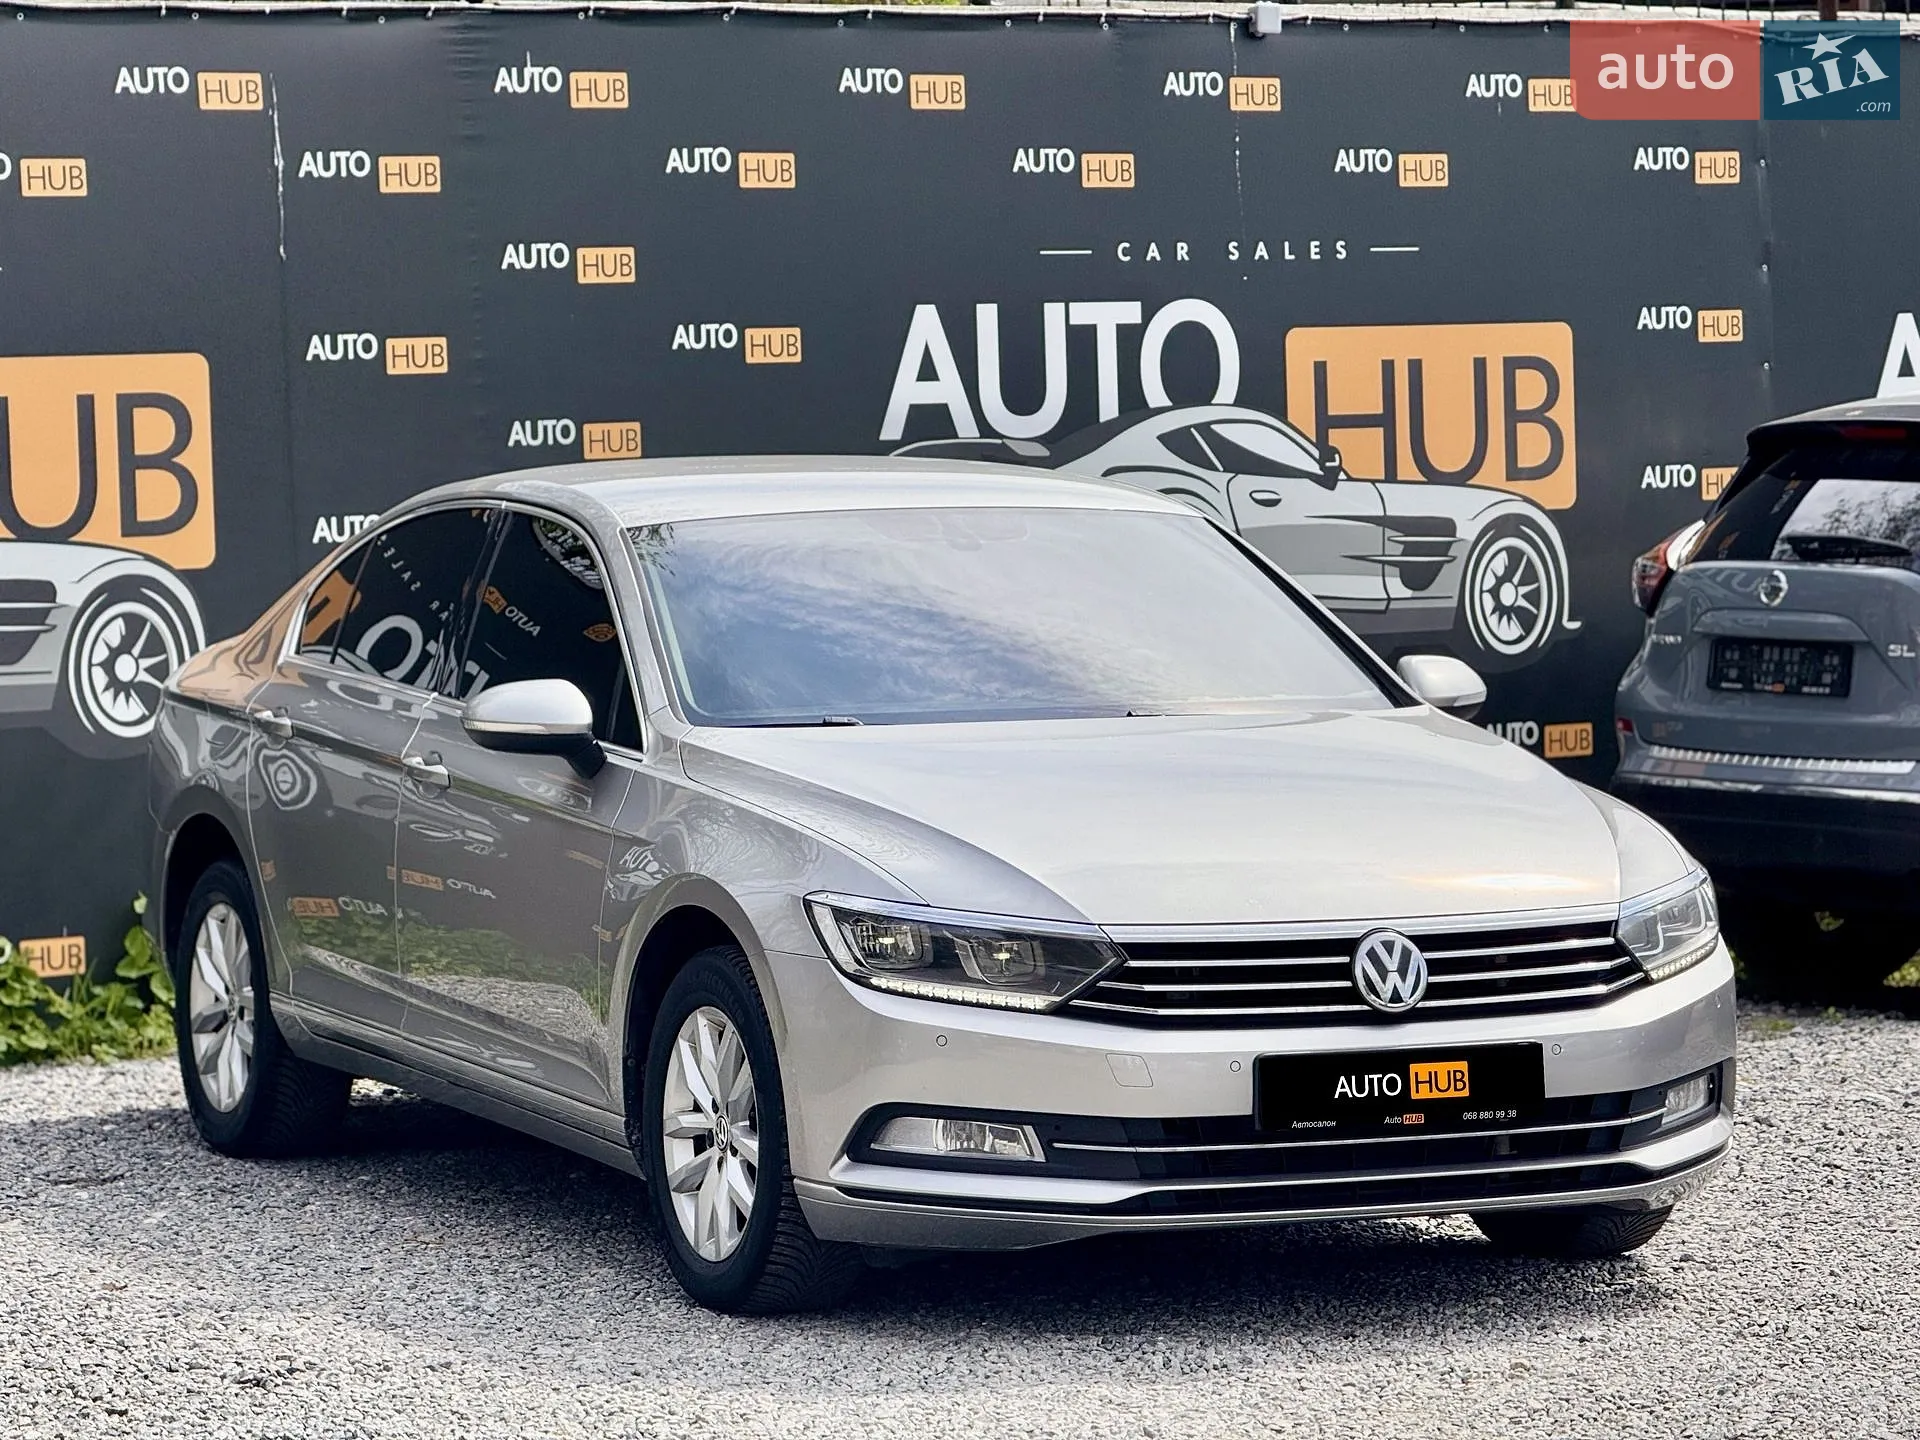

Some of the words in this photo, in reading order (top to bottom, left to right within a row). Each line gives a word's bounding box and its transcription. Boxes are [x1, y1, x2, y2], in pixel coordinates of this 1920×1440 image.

[115, 66, 189, 94] AUTO
[204, 80, 260, 104] HUB
[494, 66, 562, 93] AUTO
[575, 80, 628, 103] HUB
[839, 68, 903, 93] AUTO
[915, 82, 963, 105] HUB
[1163, 72, 1223, 96] AUTO
[1234, 84, 1279, 106] HUB
[1465, 74, 1522, 98] AUTO
[1532, 85, 1575, 107] HUB
[27, 165, 84, 191] HUB
[298, 151, 371, 178] AUTO
[384, 163, 438, 188] HUB
[666, 147, 731, 173] AUTO
[744, 159, 793, 183] HUB
[1013, 148, 1075, 173] AUTO
[1087, 160, 1132, 183] HUB
[1335, 149, 1392, 173] AUTO
[1404, 160, 1446, 183] HUB
[1634, 147, 1689, 170] AUTO
[1699, 157, 1738, 180] HUB
[501, 243, 569, 269] AUTO
[582, 254, 633, 279] HUB
[1117, 243, 1190, 262] CAR
[1228, 241, 1348, 260] SALES
[1637, 306, 1692, 329] AUTO
[1701, 315, 1741, 338] HUB
[306, 333, 378, 361] AUTO
[391, 344, 445, 369] HUB
[672, 323, 737, 350] AUTO
[750, 334, 799, 358] HUB
[879, 298, 1240, 441] AUTO
[1314, 356, 1564, 484] HUB
[508, 419, 576, 446] AUTO
[588, 429, 639, 454] HUB
[0, 392, 199, 538] UB
[1641, 464, 1696, 488] AUTO
[1549, 730, 1591, 753] HUB
[1334, 1073, 1401, 1099] AUTO
[1414, 1069, 1467, 1094] HUB
[1384, 1115, 1402, 1124] Auto
[1404, 1114, 1423, 1123] HUB
[1495, 1110, 1505, 1119] 99
[1507, 1109, 1517, 1118] 38
